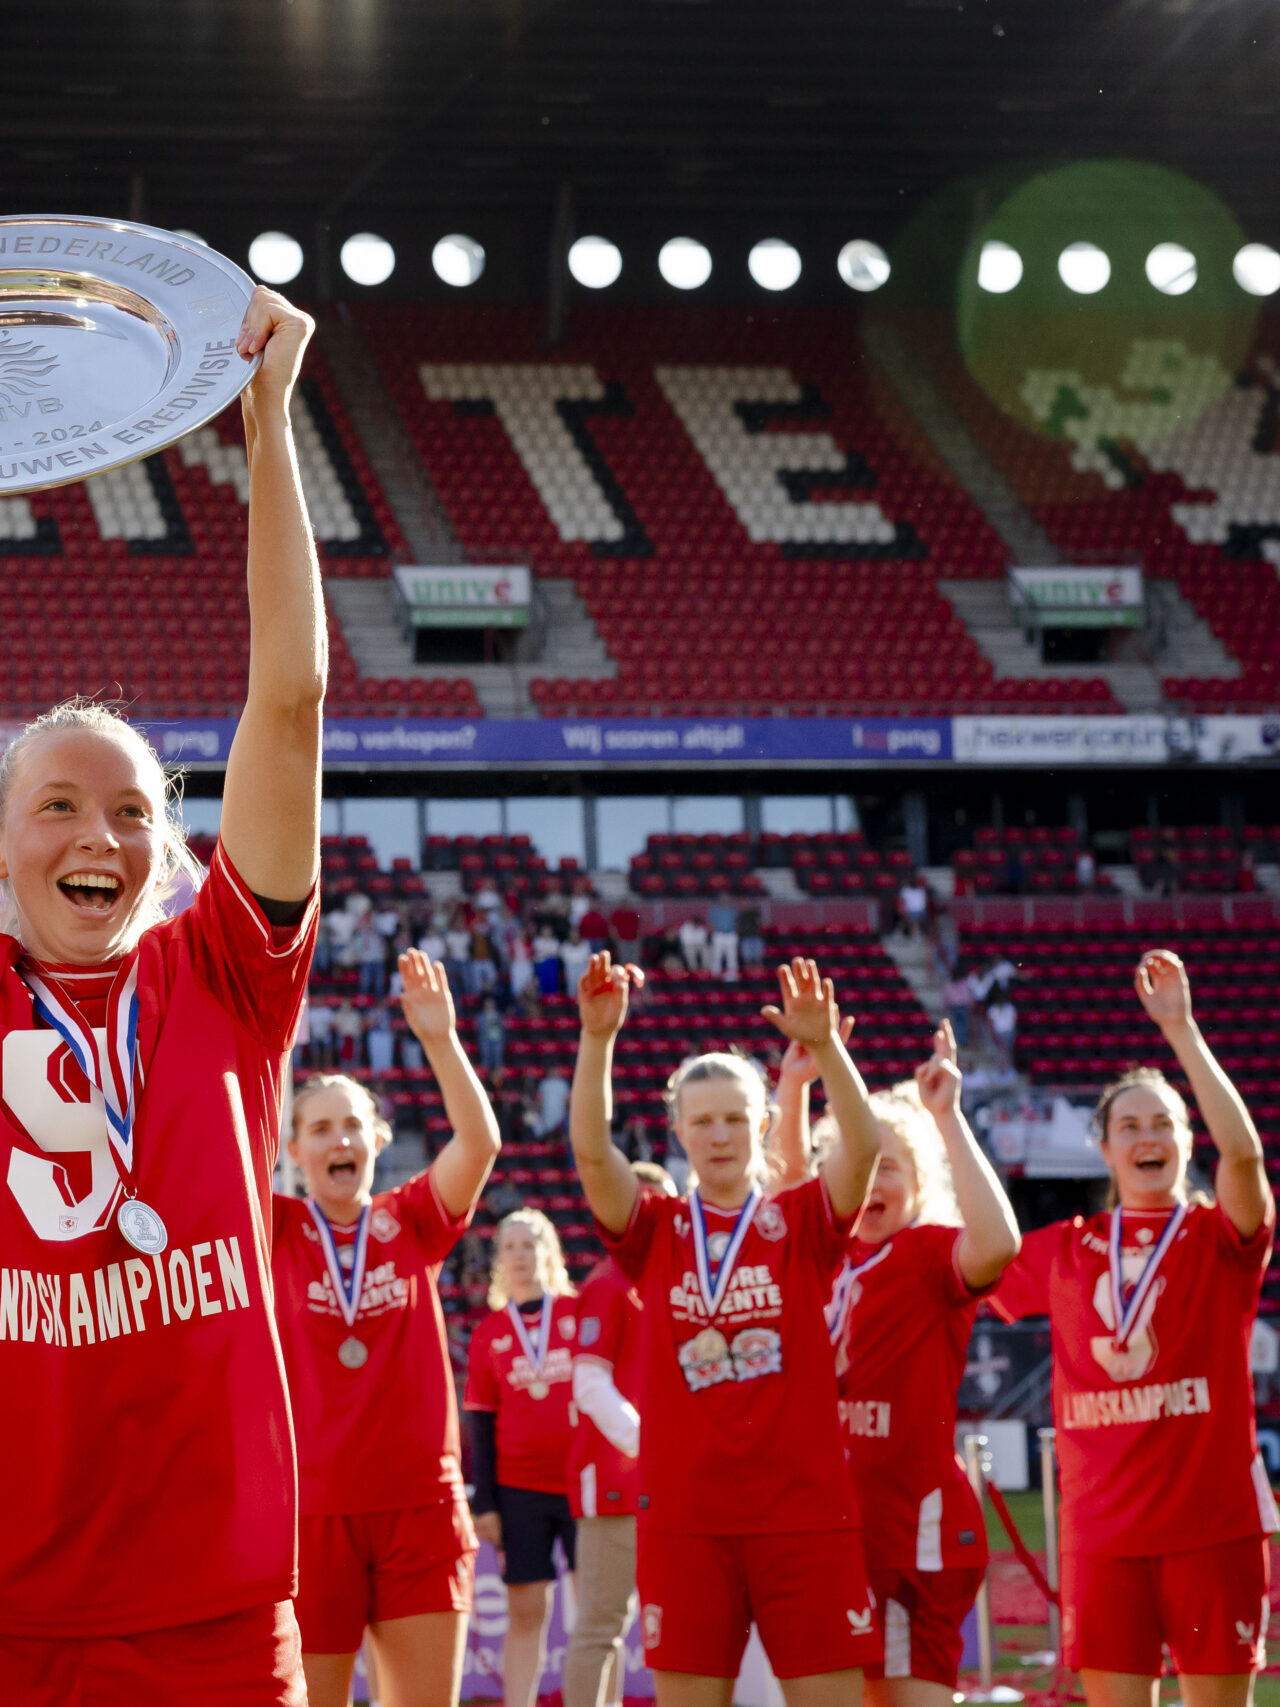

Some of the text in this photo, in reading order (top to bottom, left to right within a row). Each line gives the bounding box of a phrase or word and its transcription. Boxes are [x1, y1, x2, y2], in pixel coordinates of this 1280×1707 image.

[32, 420, 104, 446] 2024
[112, 338, 236, 445] EREDIVISIE
[2, 1027, 144, 1242] 9
